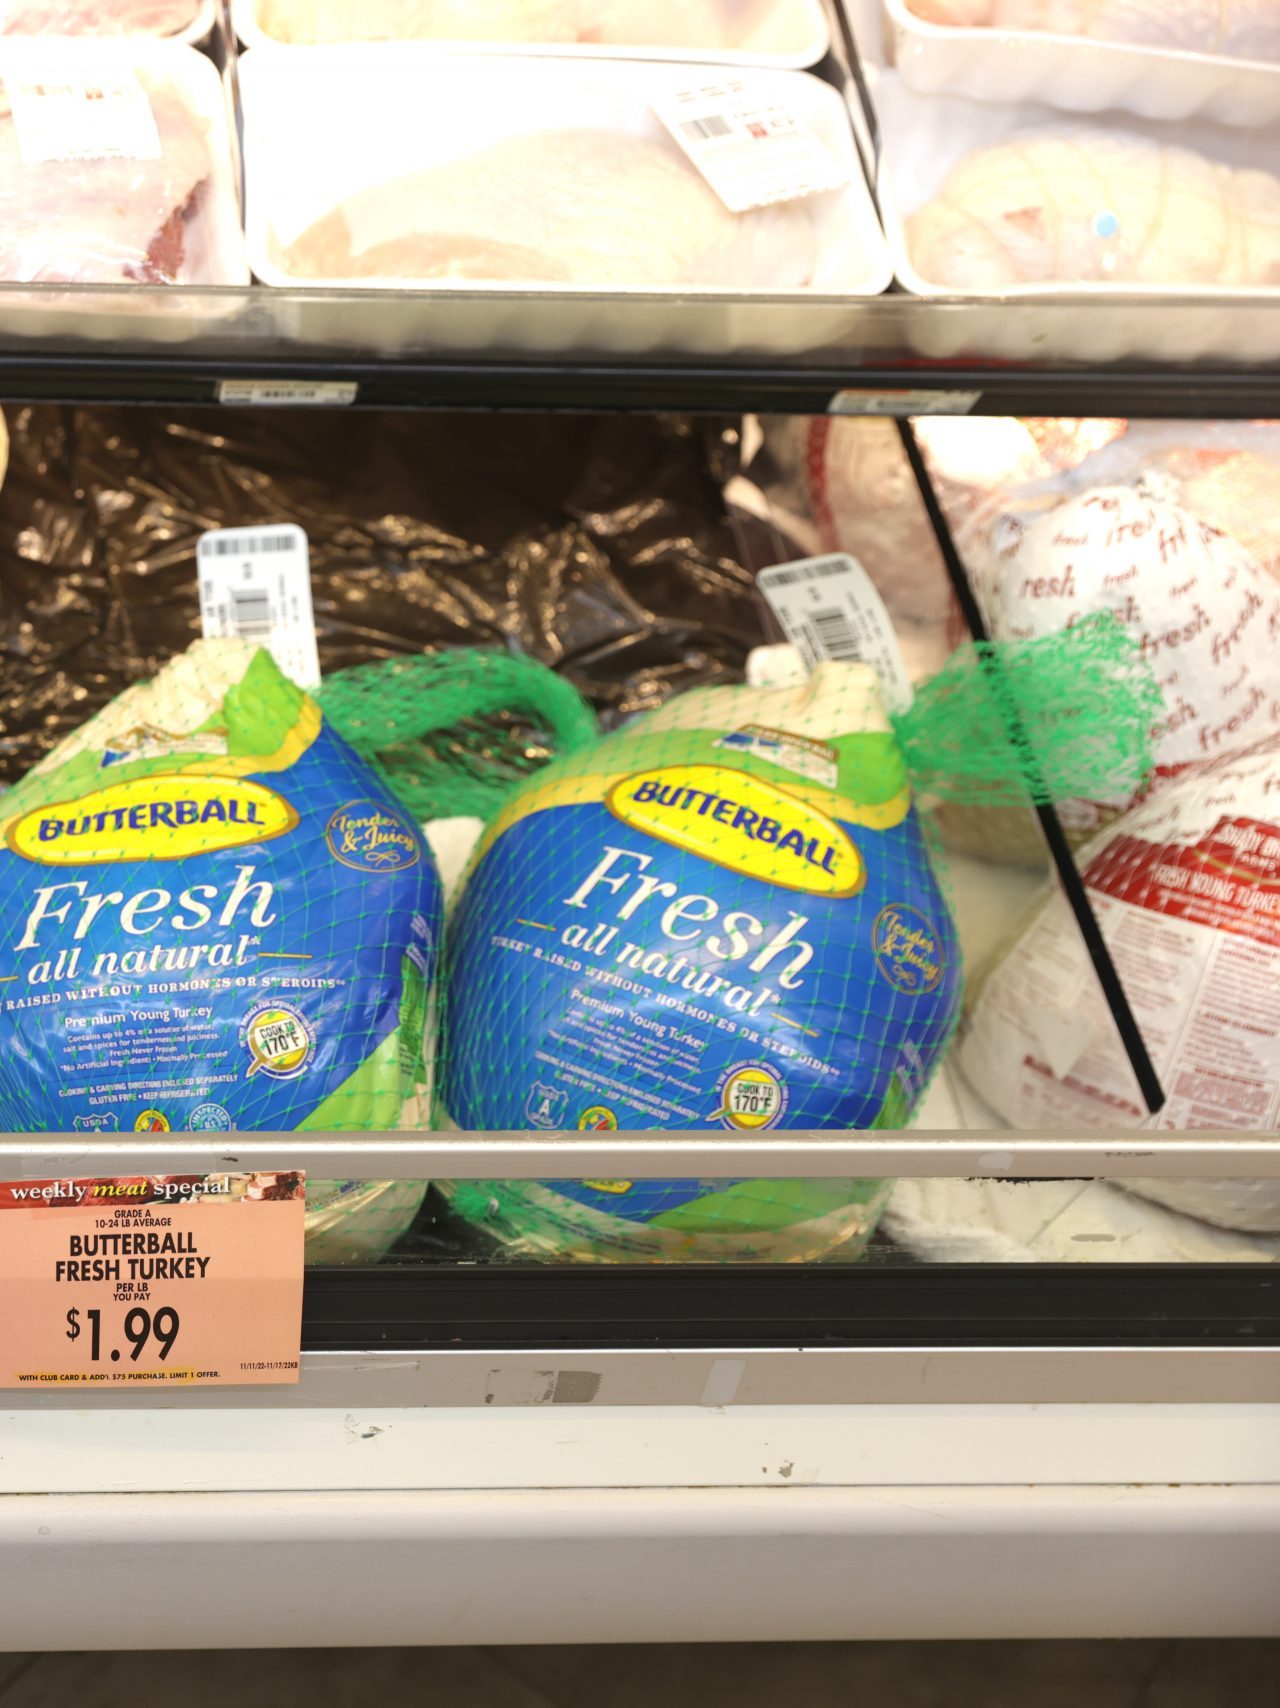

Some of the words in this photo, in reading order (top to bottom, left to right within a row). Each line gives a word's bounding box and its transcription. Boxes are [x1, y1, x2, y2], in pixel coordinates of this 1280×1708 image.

[1138, 603, 1212, 661] fresh
[1199, 686, 1265, 751] fresh
[38, 799, 266, 842] BUTTERBALL
[331, 811, 401, 834] Tender
[633, 780, 837, 876] BUTTERBALL
[340, 830, 363, 853] &
[363, 829, 416, 857] Juicy
[14, 865, 277, 953] Fresh
[563, 845, 815, 991] Fresh
[561, 921, 620, 957] all
[883, 910, 936, 953] Tender
[28, 948, 80, 986] all
[895, 947, 940, 980] Juicy
[6, 993, 61, 1011] RAISED
[65, 983, 143, 1001] WITHOUT
[148, 977, 231, 993] HORMONES
[235, 975, 257, 988] OR
[533, 947, 581, 972] RAISED
[585, 964, 653, 996] WITHOUT
[655, 990, 736, 1033] HORMONES
[740, 1027, 759, 1044] OR
[130, 1010, 170, 1023] Young
[173, 1006, 213, 1019] Turkey
[571, 988, 625, 1018] Premium
[628, 1010, 667, 1038] Young
[67, 1034, 101, 1043] Contains
[92, 1041, 118, 1050] spices
[186, 1032, 220, 1042] juiciness.
[259, 1026, 284, 1039] COOK
[264, 1031, 299, 1056] 170°F
[76, 1060, 109, 1070] Artificial
[127, 1080, 161, 1090] DIRECTIONS
[195, 1074, 239, 1085] SEPARATELY
[89, 1095, 118, 1105] GLUTEN
[734, 1094, 772, 1113] 170°F
[10, 1181, 88, 1202] weekly
[93, 1181, 149, 1198] meat
[153, 1177, 231, 1202] special
[95, 1219, 119, 1228] 10-24
[121, 1219, 131, 1228] LB
[133, 1217, 172, 1228] AVERAGE
[114, 1209, 143, 1218] GRADE
[144, 1209, 151, 1218] A
[70, 1231, 198, 1257] BUTTERBALL
[55, 1259, 120, 1282] FRESH
[128, 1256, 211, 1280] TURKEY
[113, 1293, 132, 1302] YOU
[133, 1292, 151, 1301] PAY
[116, 1283, 134, 1292] PER
[137, 1282, 148, 1292] LB
[65, 1305, 180, 1362] $1.99
[112, 1373, 126, 1381] $75
[128, 1372, 168, 1380] PURCHASE.
